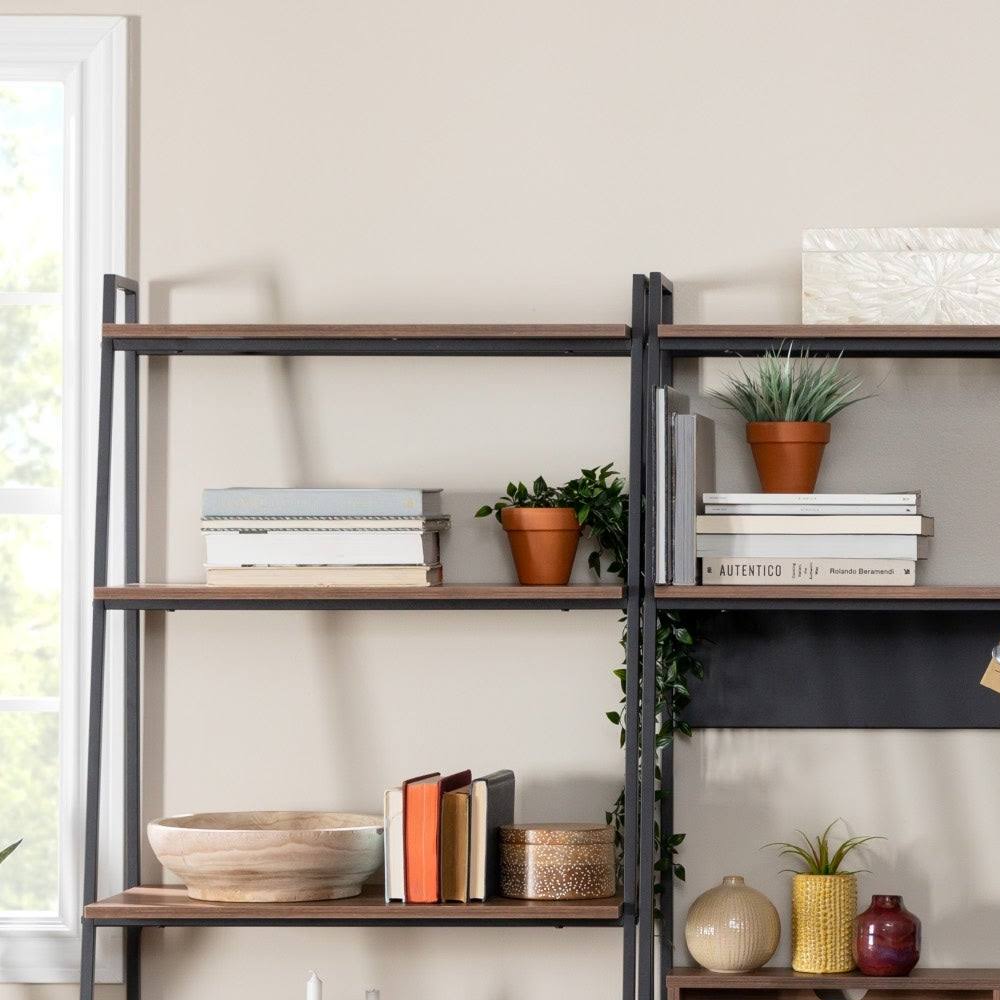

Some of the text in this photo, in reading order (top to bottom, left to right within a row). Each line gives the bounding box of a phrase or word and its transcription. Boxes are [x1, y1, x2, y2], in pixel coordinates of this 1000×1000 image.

[719, 564, 782, 577] AUTENTICO
[829, 567, 895, 575] Rolando Beramendi
